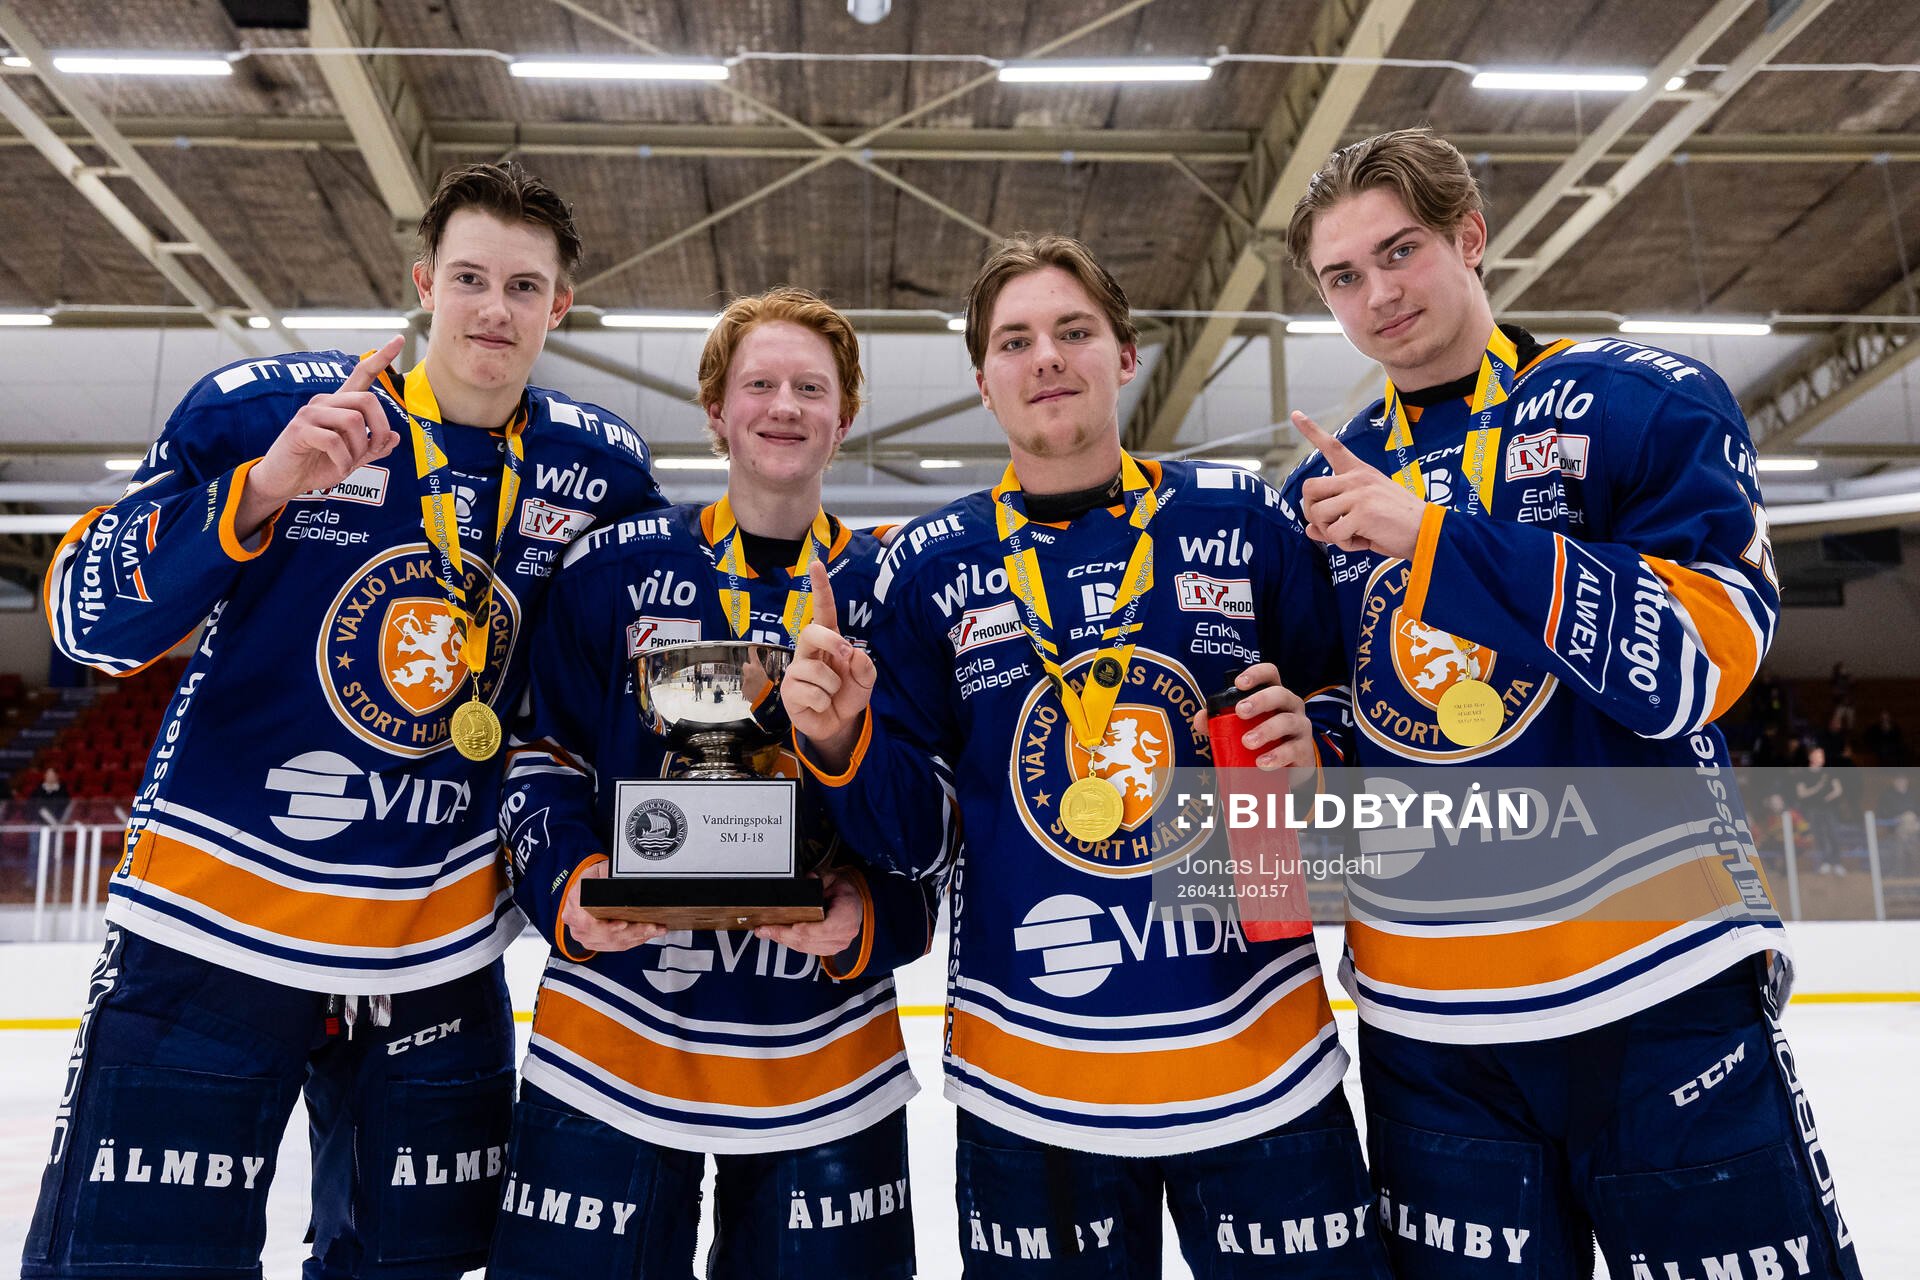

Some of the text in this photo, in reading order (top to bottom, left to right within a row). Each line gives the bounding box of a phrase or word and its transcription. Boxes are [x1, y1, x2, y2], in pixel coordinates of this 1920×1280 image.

[1514, 379, 1594, 427] wilo
[536, 462, 608, 503] wilo
[1467, 411, 1492, 516] ISHOCKEYFÖRBU
[330, 483, 381, 499] PRODUKT
[523, 547, 557, 563] Enk
[1067, 561, 1127, 579] CCM
[335, 574, 387, 643] VÄXJÖ
[389, 559, 477, 591] LAKS
[931, 562, 1009, 618] wilo
[1223, 601, 1255, 614] PROD
[1568, 563, 1600, 664] ALWEX
[972, 620, 1023, 642] PRODUKT
[1070, 624, 1105, 640] BAL
[1113, 594, 1141, 652] SVENSKA
[343, 681, 407, 737] STORT
[412, 714, 452, 744] HJÄ
[1370, 700, 1441, 745] STORT
[1021, 704, 1059, 783] VÄXJÖ
[368, 770, 472, 825] VIDA
[702, 814, 782, 827] Vandringspokal
[720, 832, 764, 844] SM J-18
[1050, 815, 1125, 861] SORT
[1109, 901, 1248, 961] VIDA
[386, 1018, 462, 1056] CCM
[1669, 1042, 1746, 1107] CCM
[90, 1139, 265, 1189] ÄLMBY
[391, 1143, 509, 1186] ÄLMB
[502, 1171, 636, 1235] ÄLMBY
[788, 1178, 907, 1229] ÄLMBY
[1379, 1187, 1530, 1264] ÄLMBY
[1217, 1204, 1371, 1256] ÄLMBY
